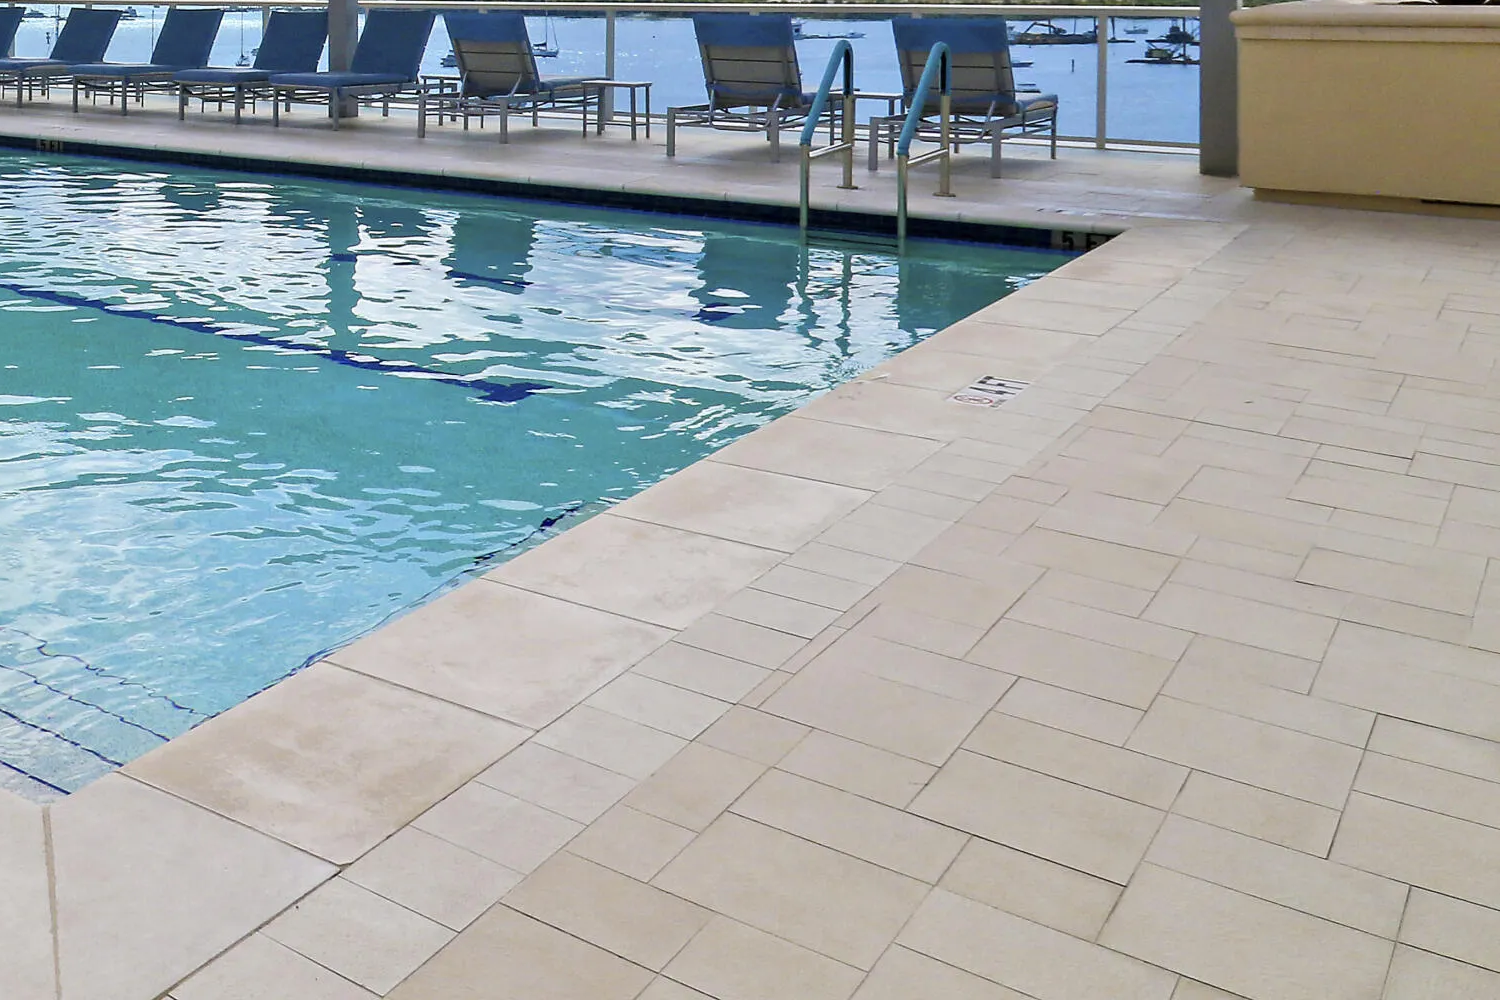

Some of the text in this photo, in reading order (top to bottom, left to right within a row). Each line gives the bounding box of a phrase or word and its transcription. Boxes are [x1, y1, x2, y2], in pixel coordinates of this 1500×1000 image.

[1061, 231, 1074, 250] 5
[968, 375, 1030, 396] 4 FT
